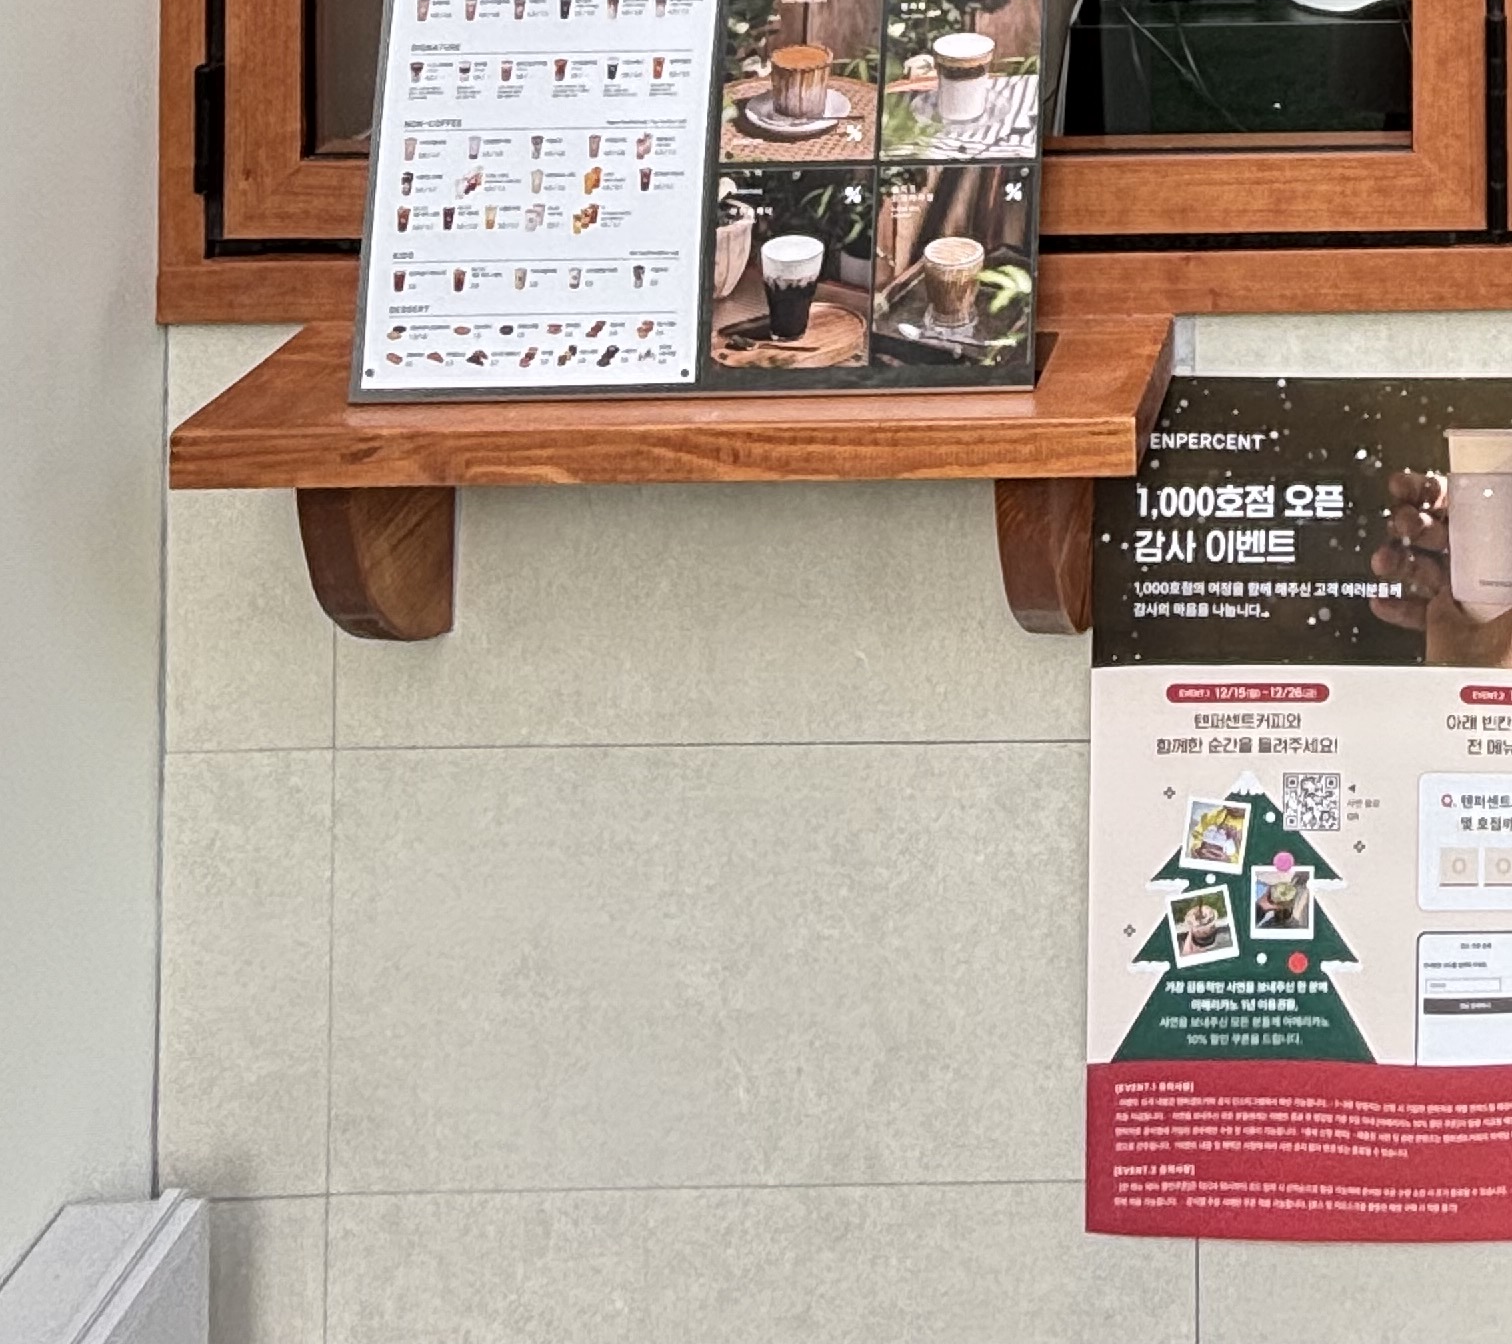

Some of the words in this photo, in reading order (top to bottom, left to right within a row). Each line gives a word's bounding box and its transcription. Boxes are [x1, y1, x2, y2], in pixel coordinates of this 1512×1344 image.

[1149, 432, 1266, 451] ENPERCENT
[1135, 483, 1275, 520] 1,000호점
[1284, 483, 1344, 519] 오픈
[1134, 529, 1197, 563] 감사
[1206, 529, 1296, 563] 이벤트
[1194, 712, 1302, 730] 텐퍼센트커피와
[1446, 714, 1477, 731] 아래
[1156, 736, 1203, 755] 함께한
[1467, 739, 1482, 755] 전
